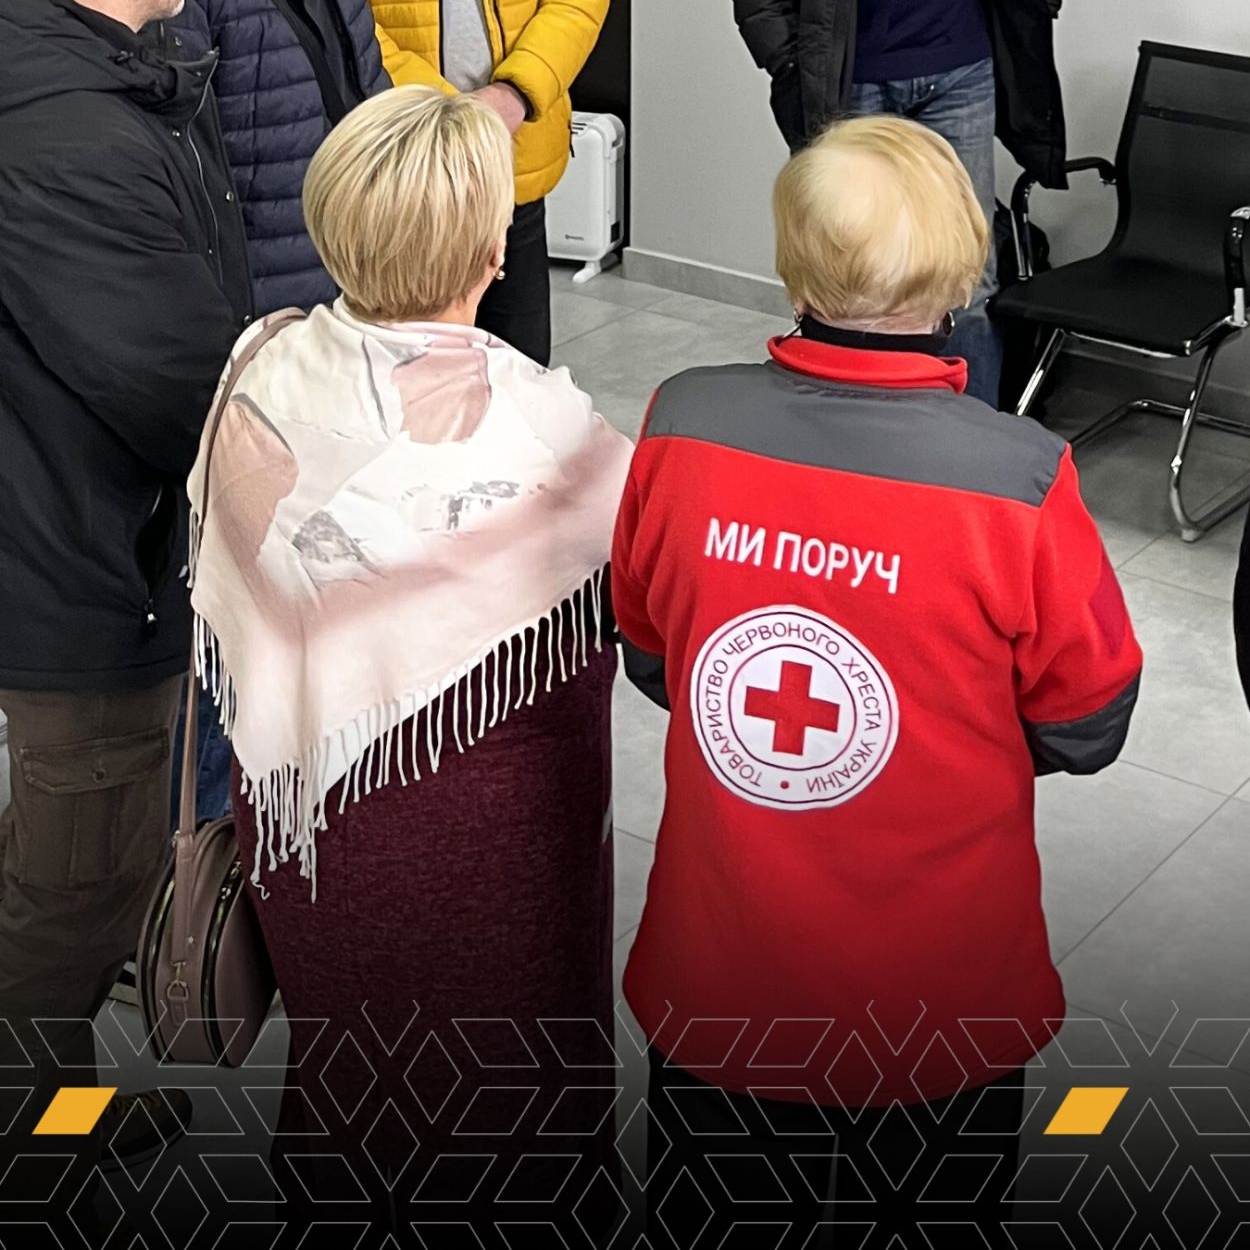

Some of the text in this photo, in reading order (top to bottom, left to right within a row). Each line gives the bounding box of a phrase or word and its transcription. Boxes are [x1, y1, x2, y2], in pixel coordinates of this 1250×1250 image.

[704, 518, 901, 594] МИ ПОРУЧ
[705, 621, 882, 794] ТОВАРИСТВО ЧЕРВОНОГО ХРЕСТА УКРАЇНИ
